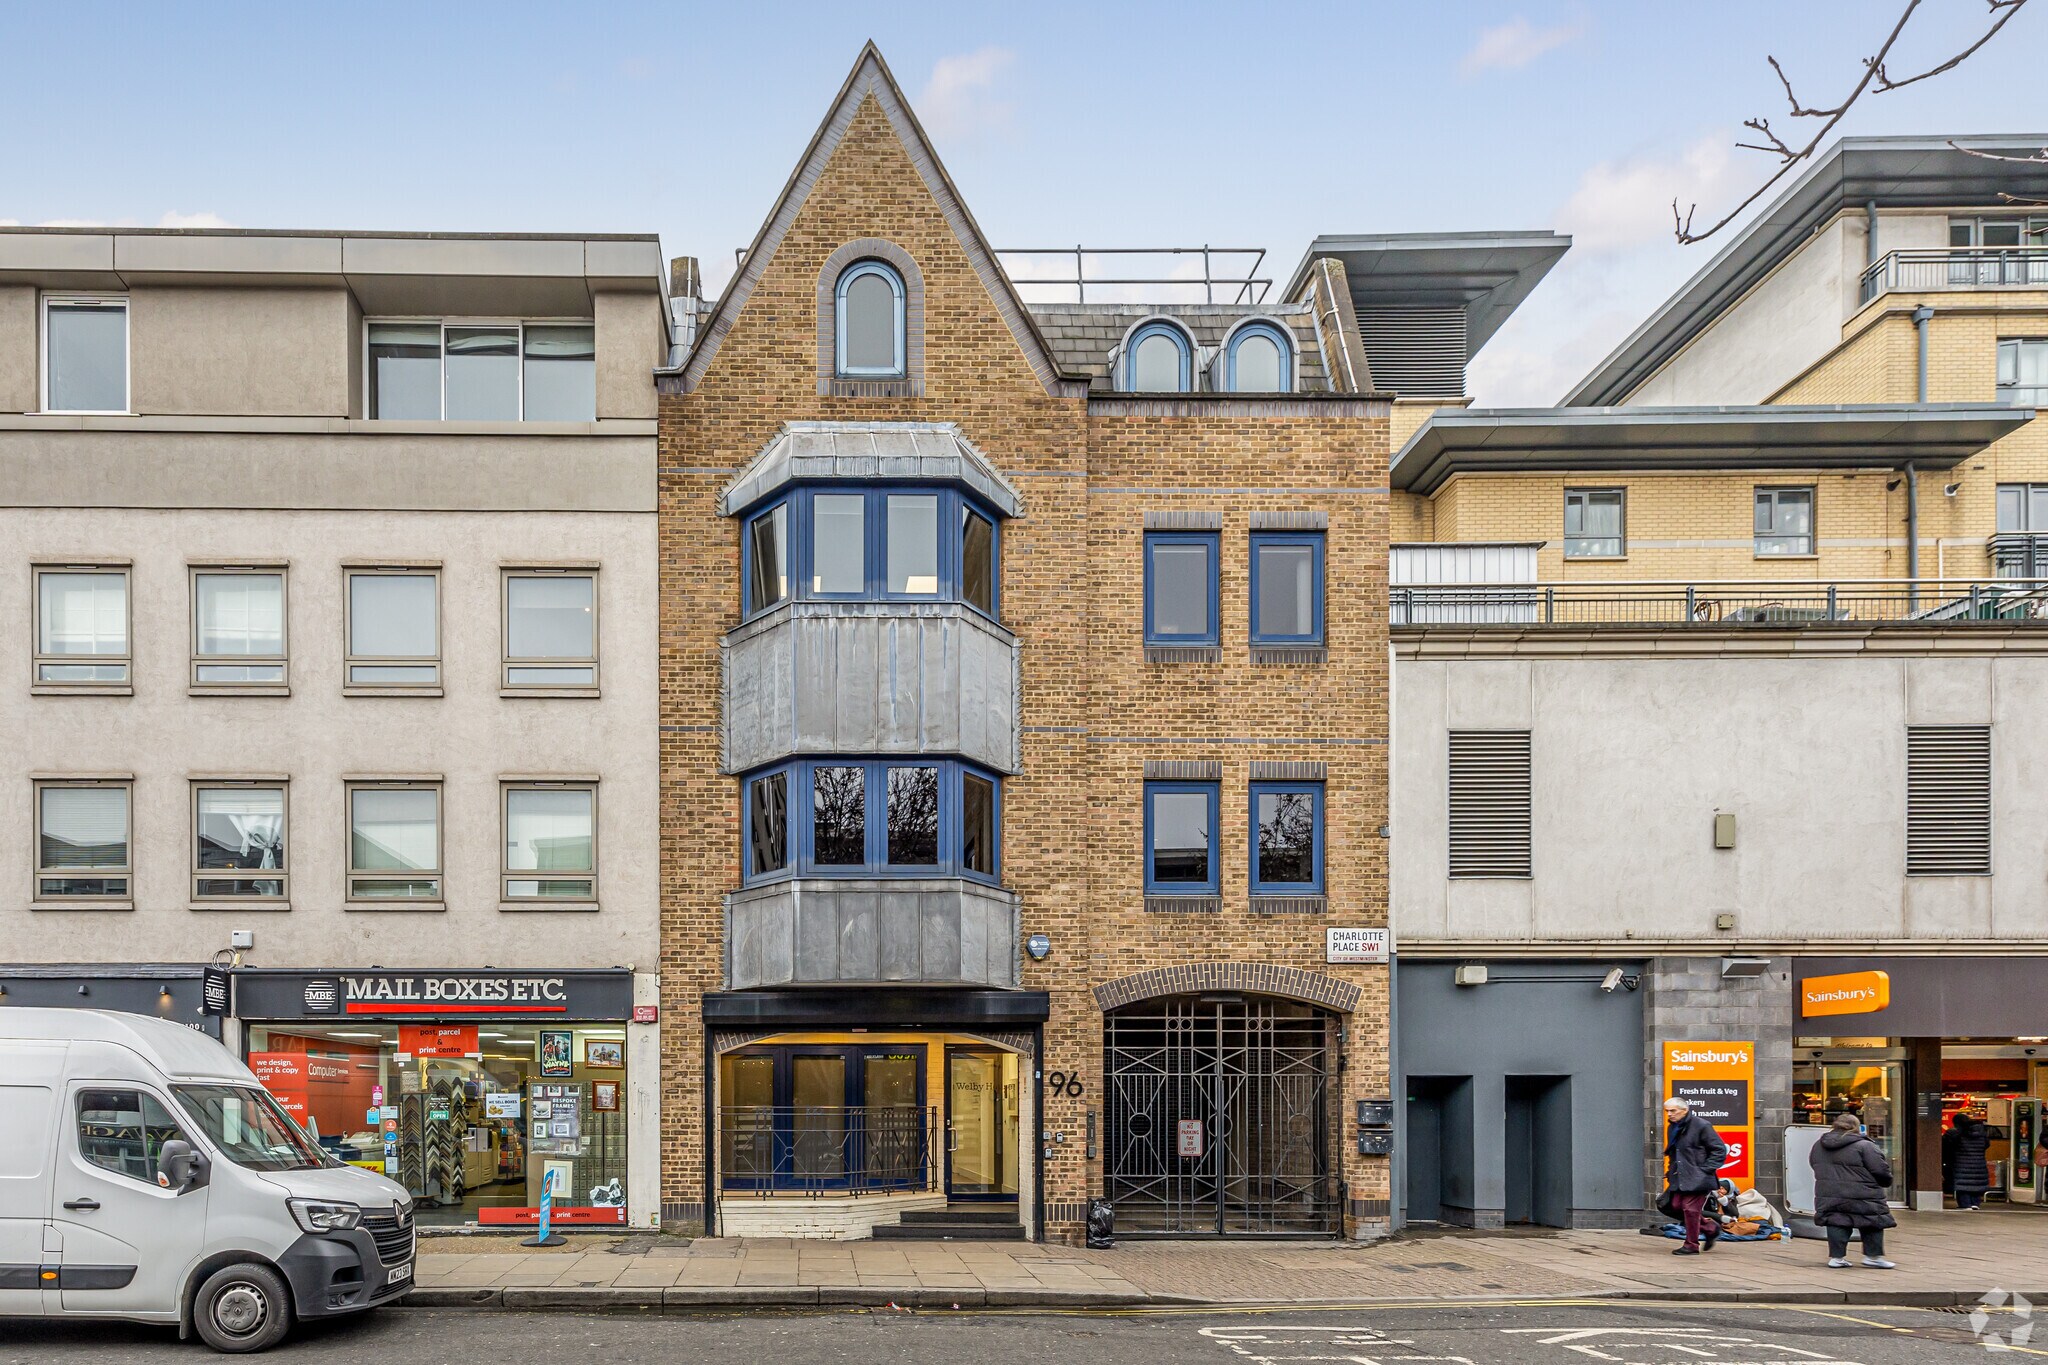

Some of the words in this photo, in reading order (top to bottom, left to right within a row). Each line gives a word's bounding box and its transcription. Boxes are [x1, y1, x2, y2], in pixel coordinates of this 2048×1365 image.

[1333, 931, 1383, 941] CHARLOTTE
[1333, 942, 1359, 952] PLACE
[1362, 942, 1379, 952] SW1
[208, 987, 224, 1000] MBE
[346, 978, 420, 1000] MAIL
[424, 978, 509, 1000] BOXES
[511, 978, 567, 1000] ETC.
[308, 991, 333, 1000] MBE
[1807, 986, 1876, 1003] Sainsbury's
[420, 1028, 437, 1037] post,
[438, 1028, 461, 1037] parcel
[437, 1038, 443, 1046] &
[419, 1046, 436, 1055] print
[438, 1046, 461, 1054] centre
[268, 1058, 293, 1067] design,
[1671, 1050, 1748, 1066] Sainsbury's
[282, 1067, 299, 1075] copy
[308, 1063, 337, 1079] Computer
[955, 1082, 984, 1092] Welby
[1049, 1071, 1083, 1098] 96
[1724, 1088, 1738, 1097] Veg
[284, 1102, 304, 1110] arcels
[1685, 1099, 1705, 1107] akery
